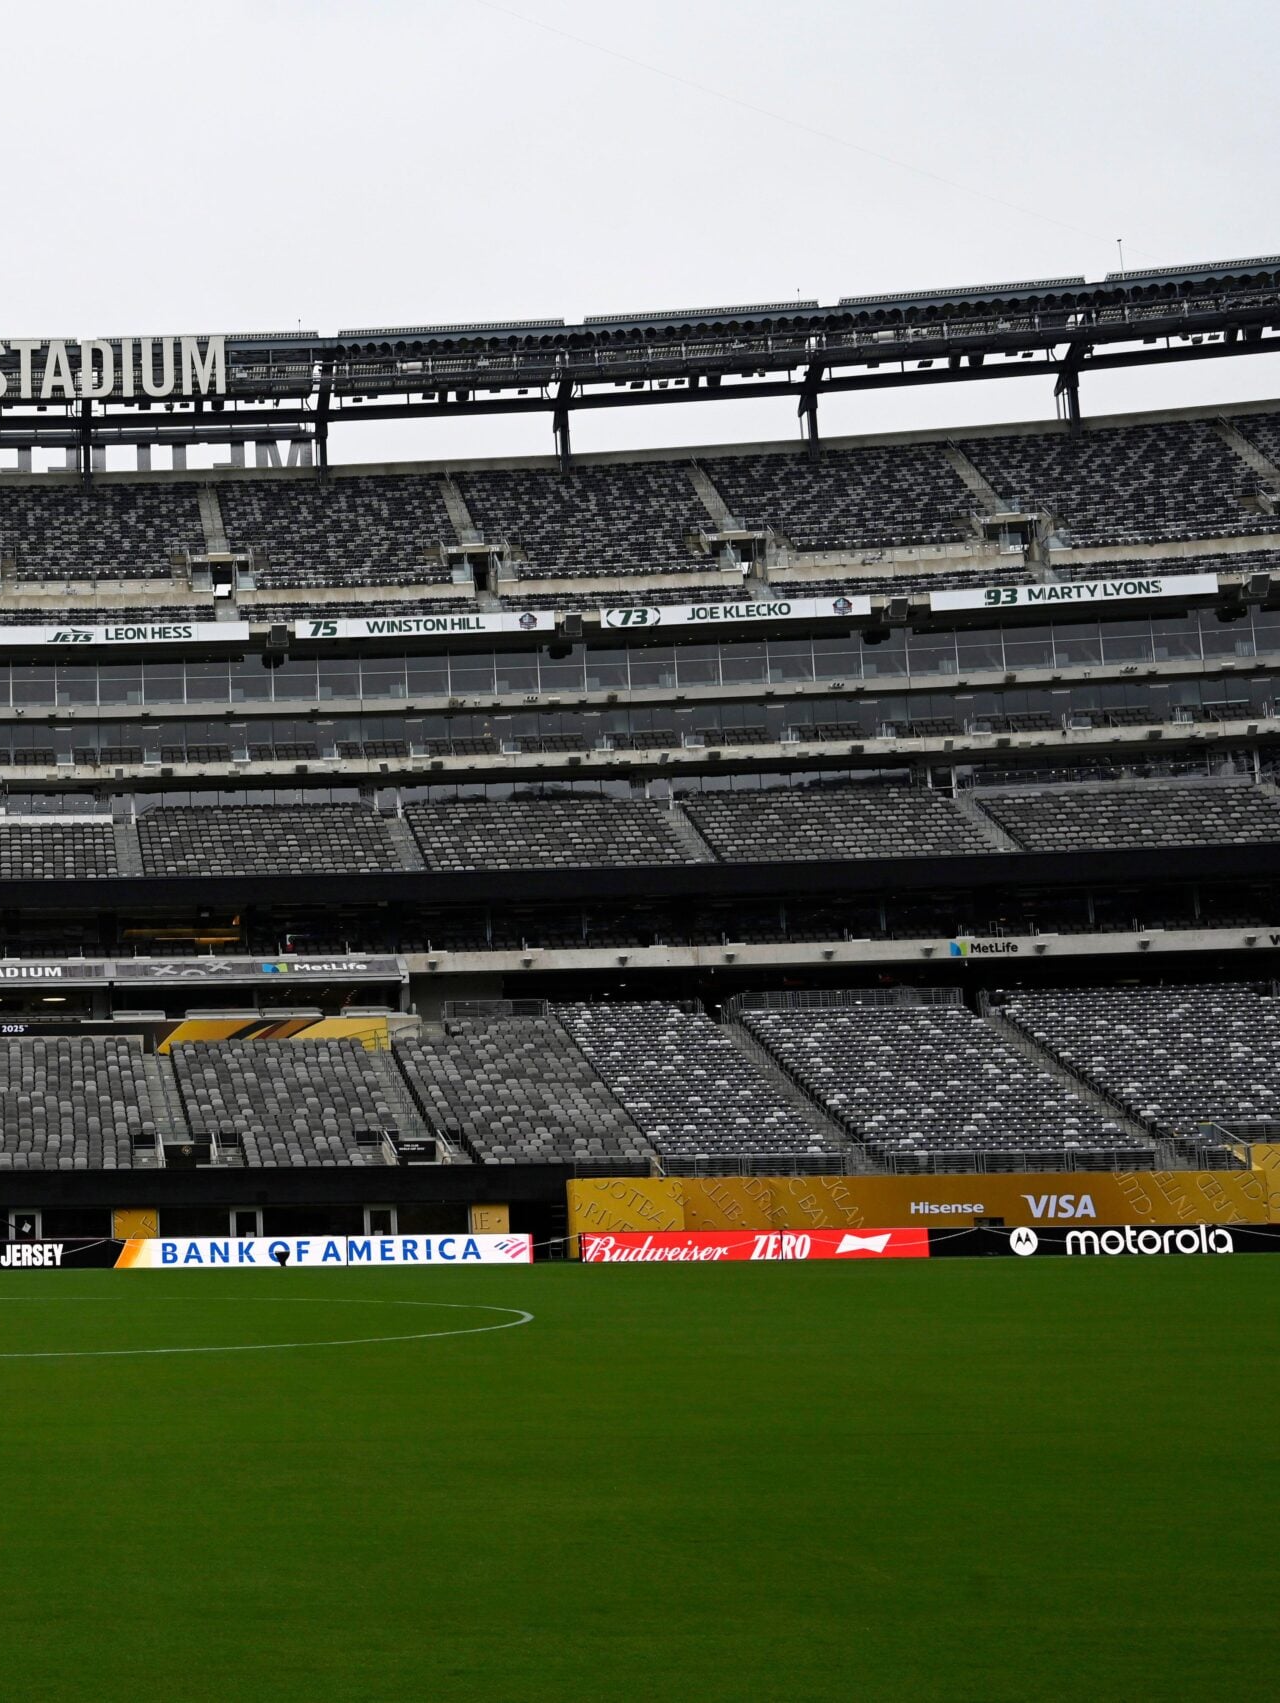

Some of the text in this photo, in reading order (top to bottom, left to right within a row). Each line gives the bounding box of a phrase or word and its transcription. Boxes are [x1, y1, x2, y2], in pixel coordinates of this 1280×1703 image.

[984, 579, 1163, 606] 93 MARTY LYONS
[619, 603, 791, 626] 73 JOE KLECKO
[47, 625, 193, 643] JETS LEON HESS
[309, 616, 486, 637] 75 WINSTON HILL
[970, 941, 1018, 954] MetLife
[293, 961, 367, 972] MetLife
[910, 1200, 984, 1214] Hisense
[1021, 1194, 1096, 1218] VISA
[161, 1238, 482, 1265] BANK OF AMERICA
[583, 1234, 811, 1263] Budweiser ZERO
[1066, 1225, 1234, 1255] motorola
[0, 1244, 63, 1267] JERSEY
